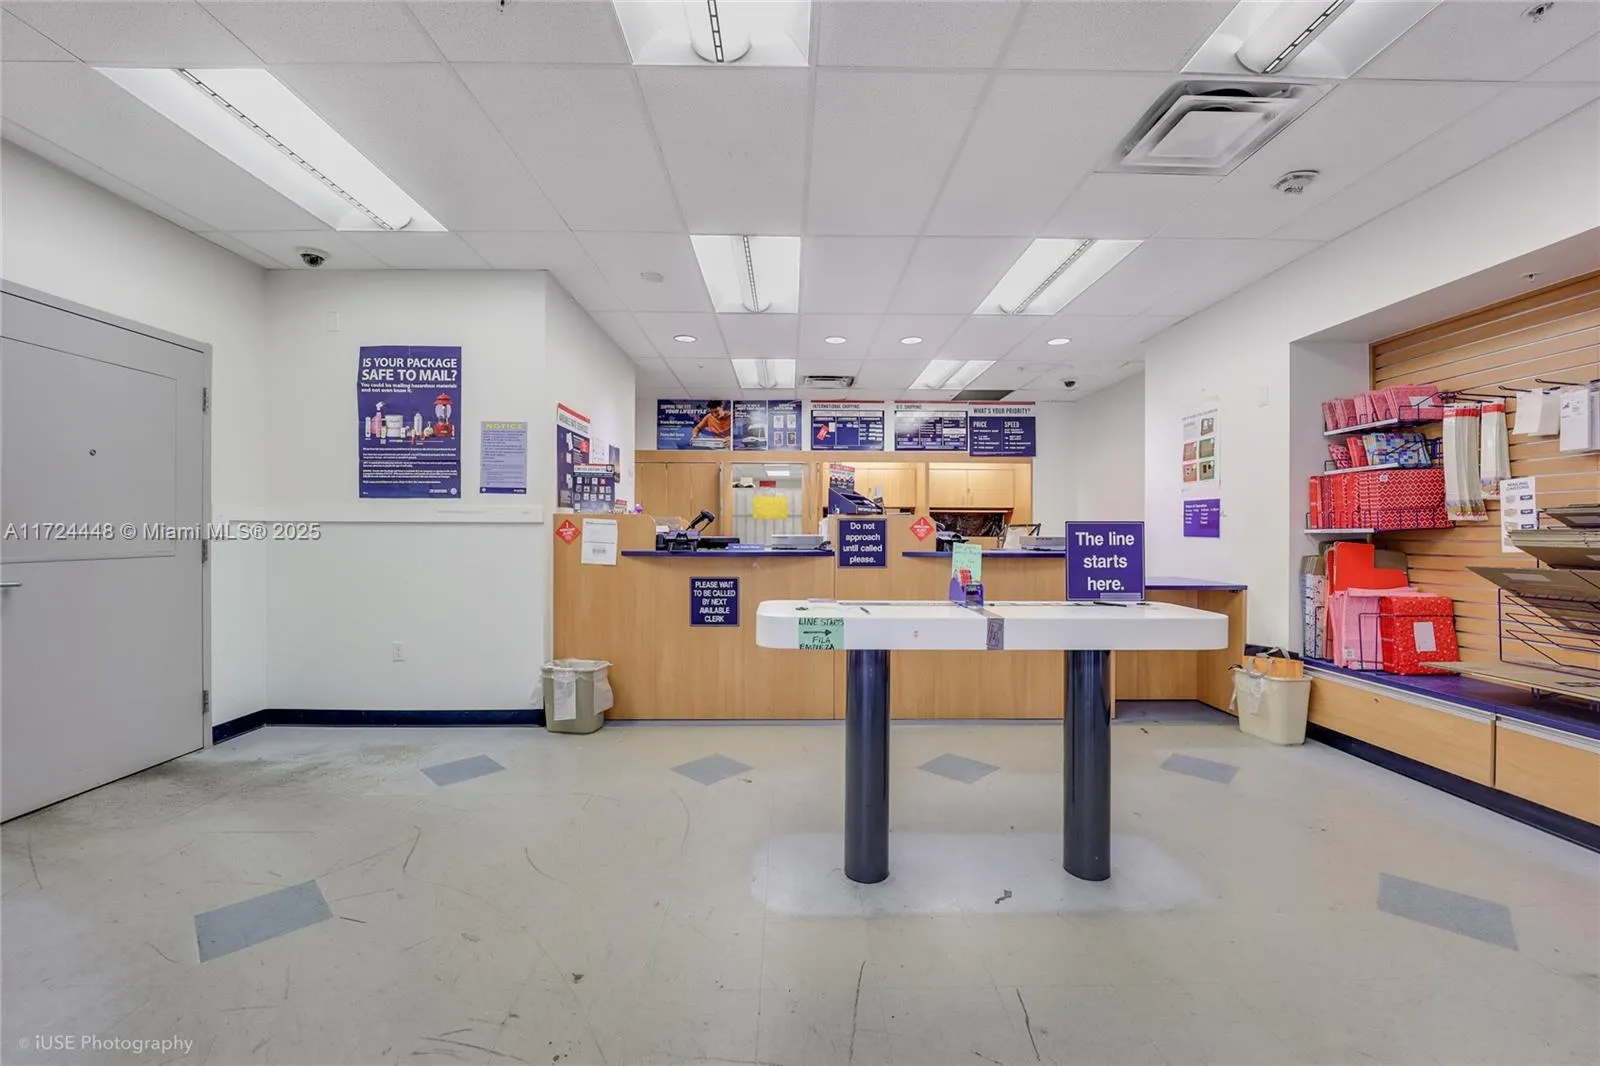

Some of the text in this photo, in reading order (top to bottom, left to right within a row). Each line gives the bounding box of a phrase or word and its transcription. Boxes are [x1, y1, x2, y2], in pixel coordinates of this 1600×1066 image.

[362, 358, 458, 368] IS YOUR PACKAGE
[362, 369, 458, 382] SAFE TO MAIL?
[846, 534, 880, 542] approach
[1075, 532, 1134, 546] The line
[1084, 555, 1128, 568] starts
[1088, 576, 1124, 591] here.
[799, 618, 844, 626] LINE STARTS
